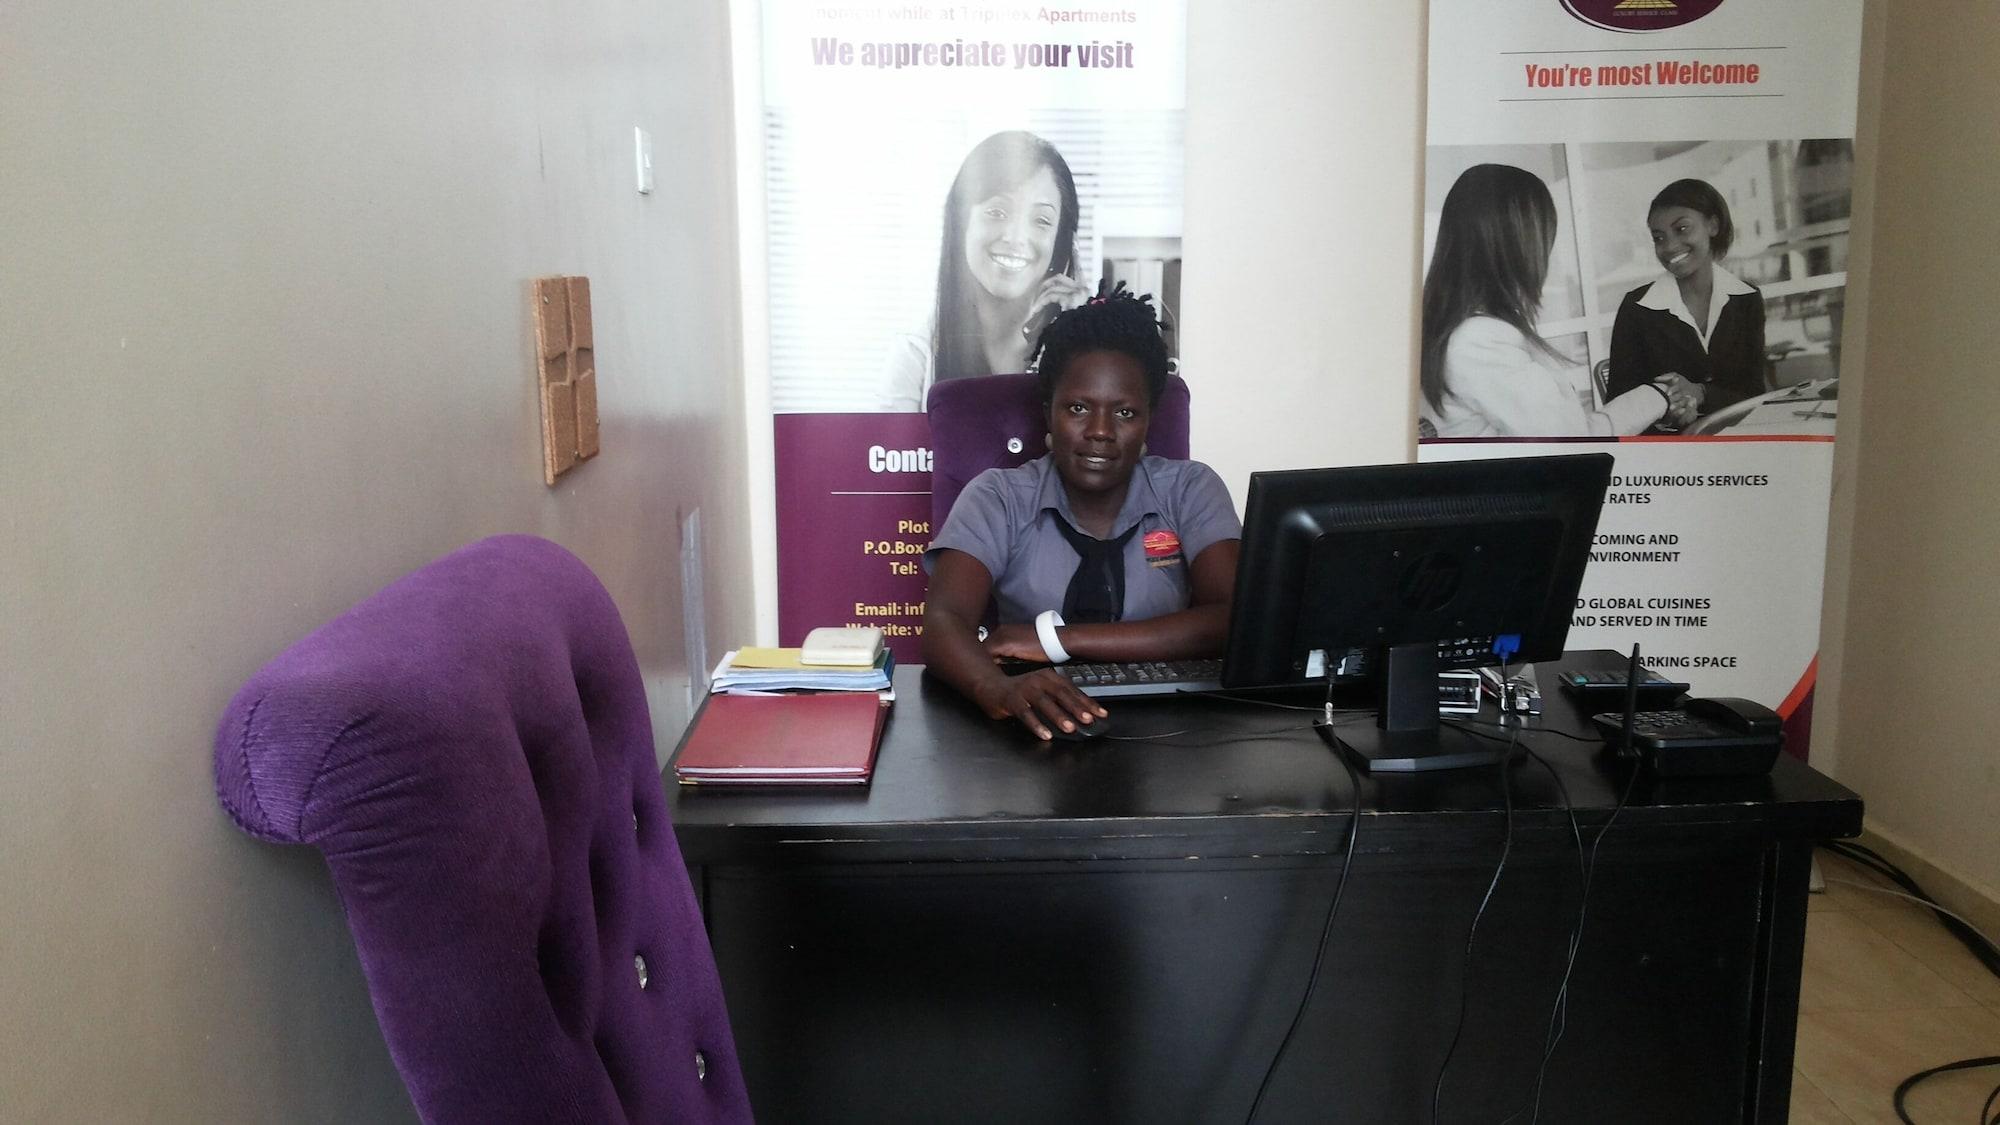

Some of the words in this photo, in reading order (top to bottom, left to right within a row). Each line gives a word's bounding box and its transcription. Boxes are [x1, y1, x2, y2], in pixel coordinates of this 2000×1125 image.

[1038, 6, 1137, 24] Apartments
[811, 37, 854, 65] We
[861, 38, 1006, 69] appreciate
[1013, 43, 1071, 70] your
[1078, 40, 1134, 68] visit
[1525, 63, 1591, 88] You're
[1598, 63, 1651, 86] most
[1657, 61, 1760, 86] Welcome
[1626, 476, 1704, 487] LUXURIOUS
[1707, 475, 1768, 487] SERVICES
[1609, 493, 1651, 504] RATES
[898, 520, 929, 534] Plot
[1648, 534, 1678, 545] AND
[864, 541, 924, 555] P.O.Box
[890, 562, 918, 575] Tel:
[855, 602, 902, 616] Email:
[1589, 598, 1644, 609] GLOBAL
[1647, 598, 1711, 609] CUISINES
[1600, 616, 1652, 627] SERVED
[1656, 616, 1671, 627] IN
[1674, 616, 1708, 627] TIME
[846, 622, 911, 636] site:
[1633, 656, 1690, 668] ARKING
[1693, 656, 1737, 668] SPACE
